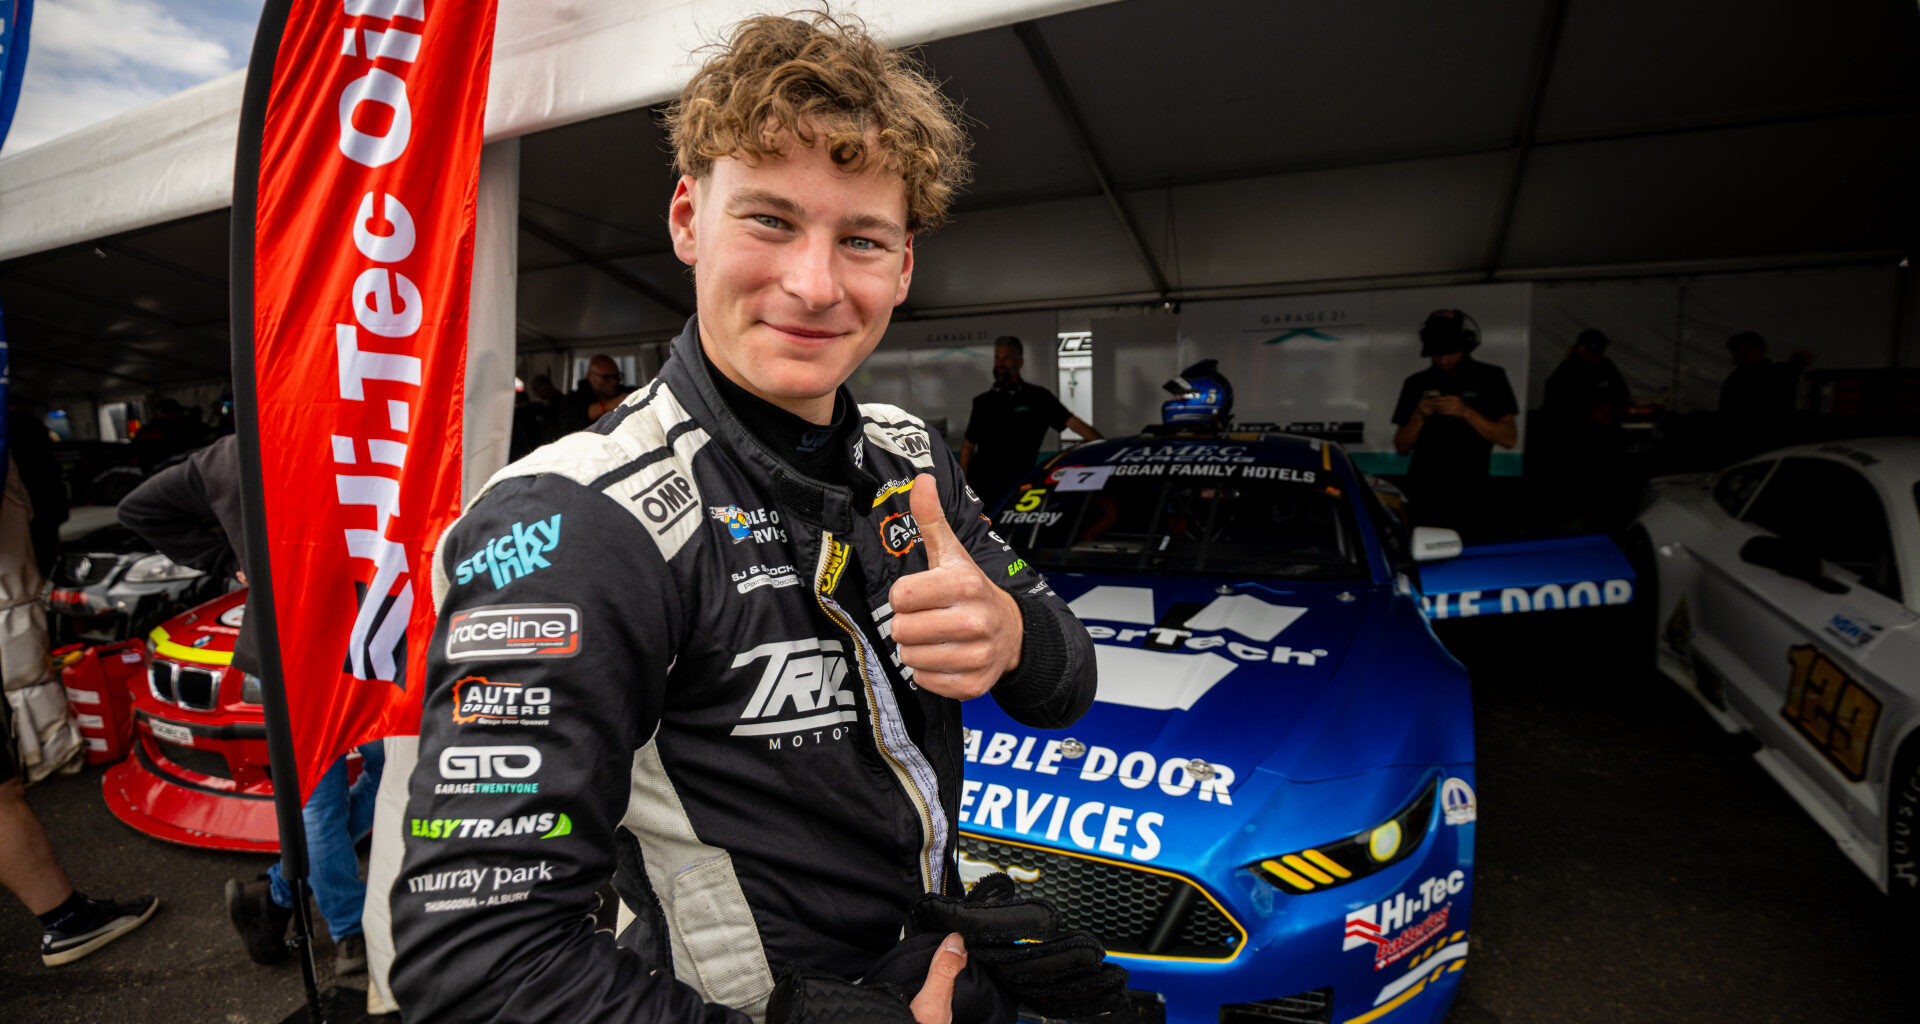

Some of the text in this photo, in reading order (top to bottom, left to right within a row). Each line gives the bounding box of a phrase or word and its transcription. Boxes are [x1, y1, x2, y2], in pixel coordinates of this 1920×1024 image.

[1261, 312, 1325, 325] GARAGE
[332, 191, 423, 558] Hi-Tec
[1078, 472, 1095, 483] 7
[1169, 463, 1238, 478] FAMILY
[1242, 465, 1316, 483] HOTELS
[641, 476, 695, 524] OMP
[1015, 489, 1047, 512] 5
[1000, 509, 1064, 527] Tracey
[731, 571, 747, 582] SJ
[749, 565, 760, 575] &
[820, 540, 843, 592] OMP
[452, 616, 566, 643] raceline
[465, 685, 551, 706] AUTO
[461, 704, 551, 716] OPENERS
[1780, 643, 1883, 784] 129
[440, 746, 542, 780] GTO
[1079, 746, 1235, 805] DOOR
[411, 812, 556, 839] EASYTRANS
[408, 861, 554, 893] murray park
[486, 889, 532, 907] ALBURY
